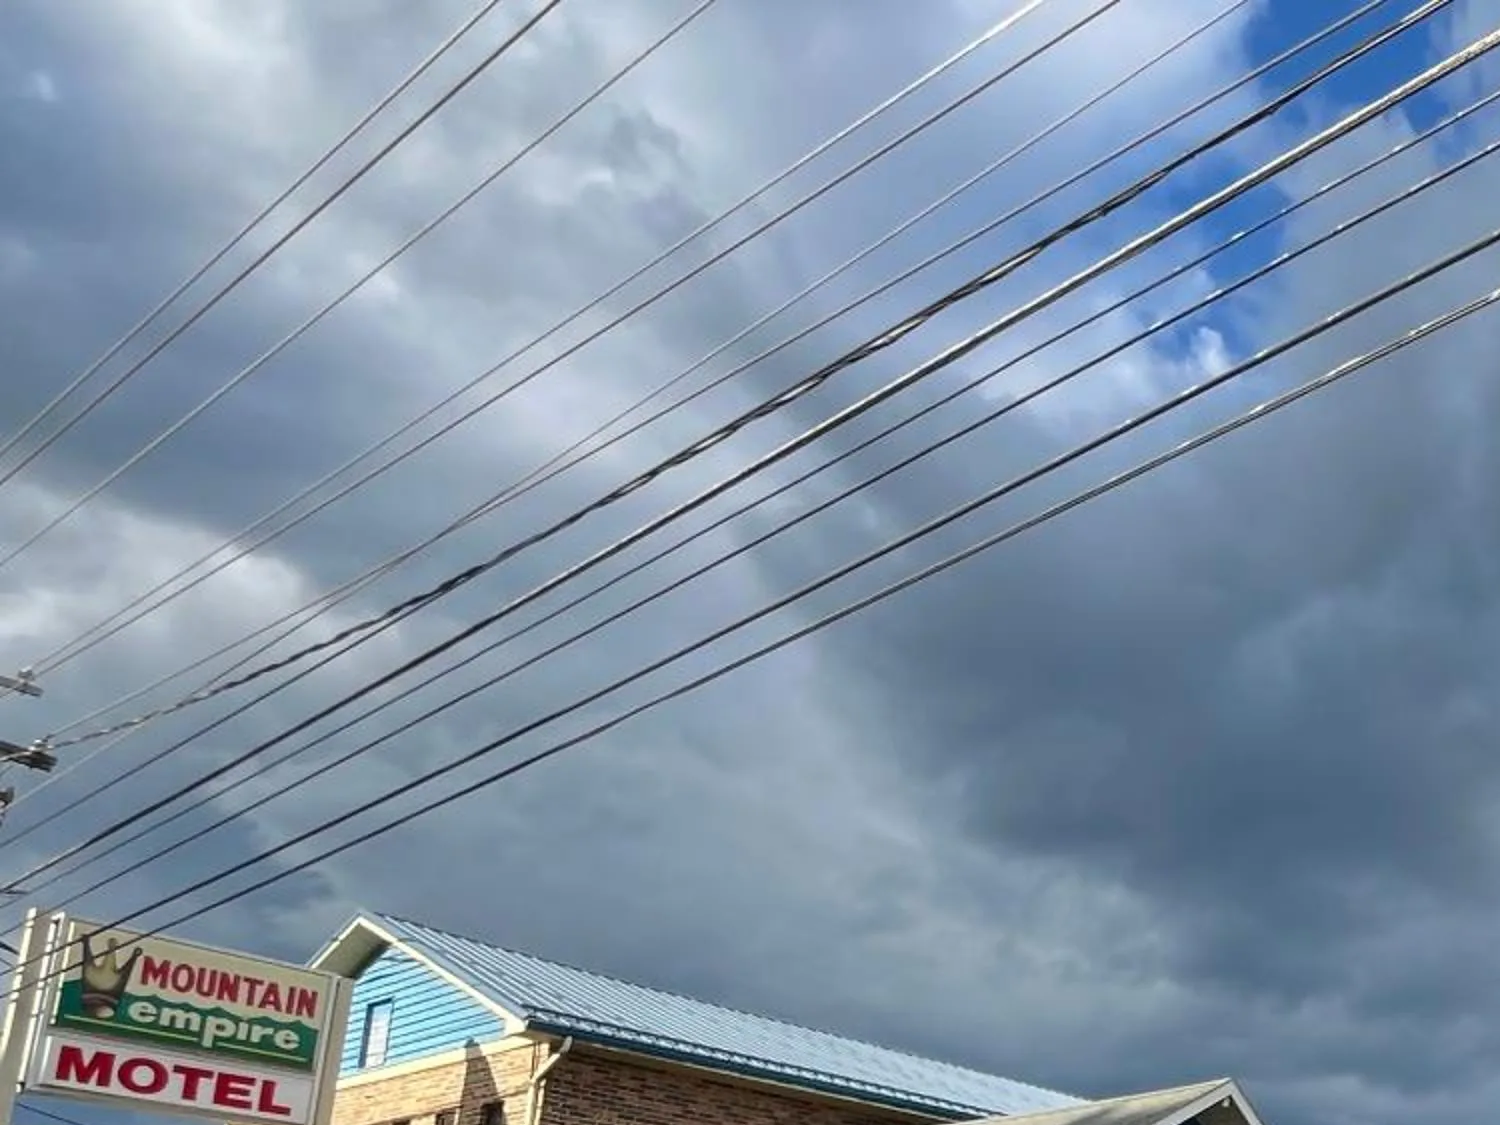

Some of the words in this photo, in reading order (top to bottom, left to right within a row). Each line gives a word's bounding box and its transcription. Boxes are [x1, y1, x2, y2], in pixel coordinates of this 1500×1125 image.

[141, 956, 318, 1018] MOUNTAIN
[128, 1001, 300, 1050] empire
[55, 1045, 291, 1116] MOTEL
